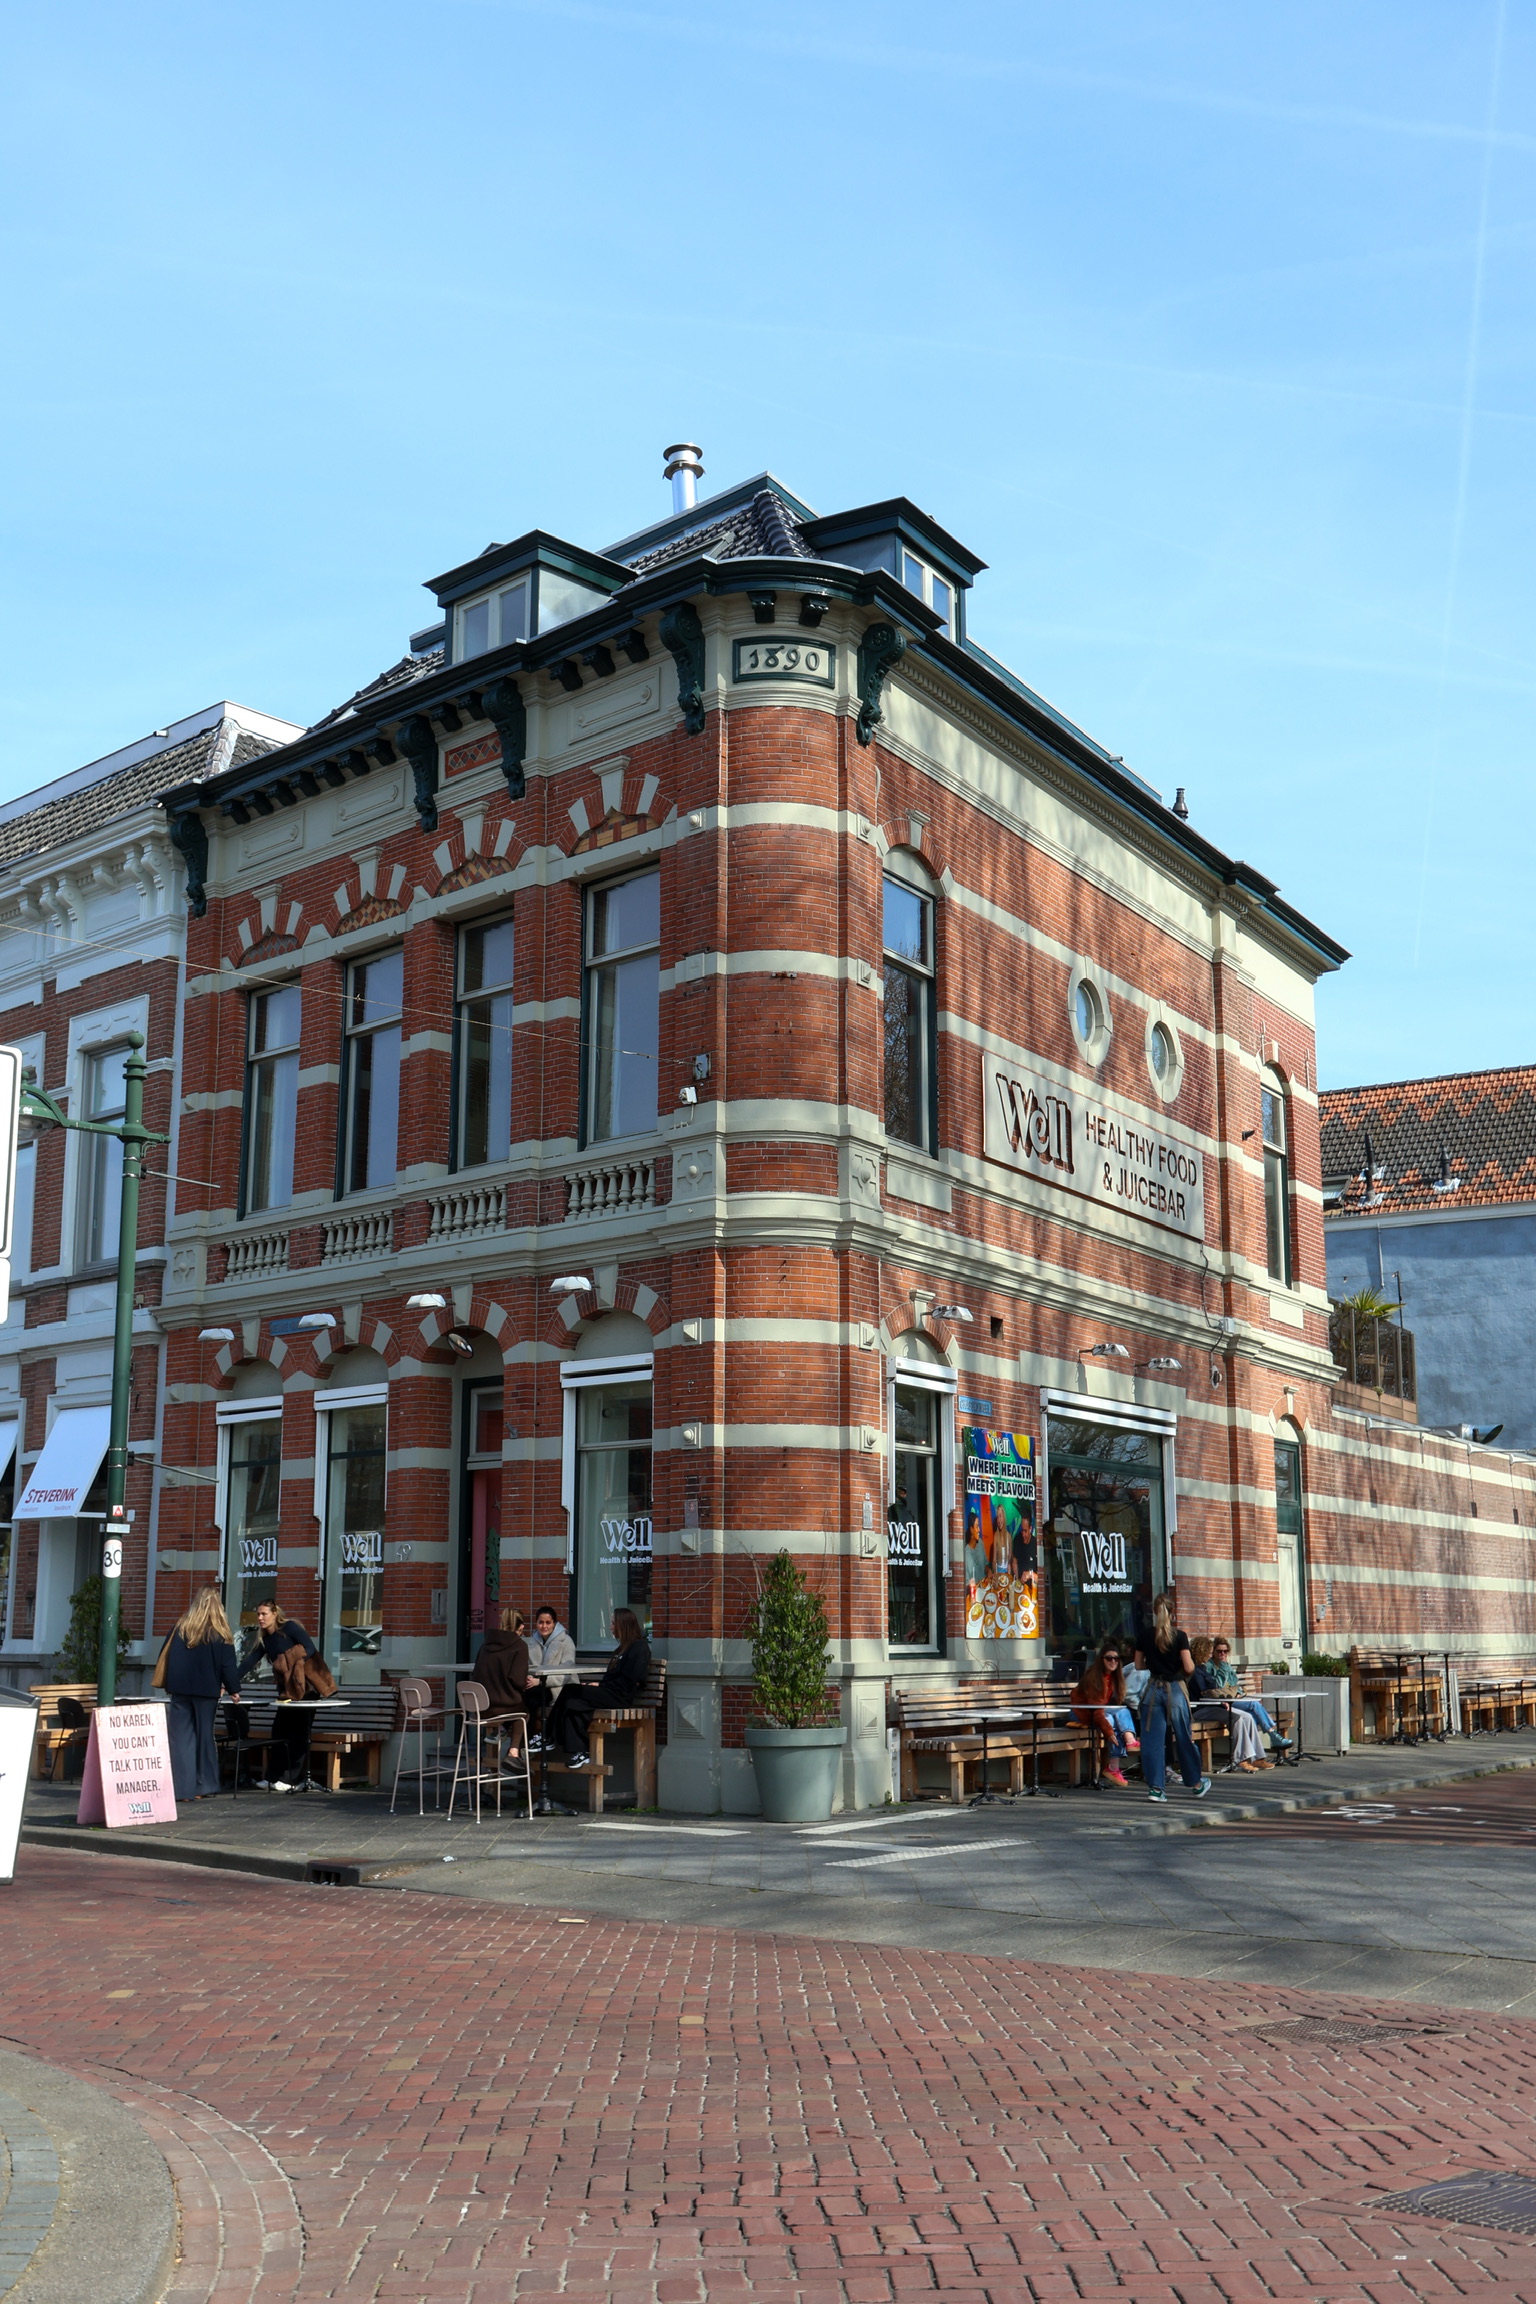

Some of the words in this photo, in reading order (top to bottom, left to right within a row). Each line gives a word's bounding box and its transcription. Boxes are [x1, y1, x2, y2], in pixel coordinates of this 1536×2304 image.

[749, 645, 820, 671] 1890
[995, 1072, 1074, 1175] Well
[1085, 1110, 1155, 1168] HEALTHY
[1158, 1144, 1198, 1187] FOOD
[1102, 1161, 1113, 1192] &
[1115, 1167, 1186, 1221] JUICEBAR
[992, 1437, 1010, 1457] Well
[968, 1457, 1000, 1475] WHERE
[1001, 1462, 1032, 1480] HEALTH
[25, 1488, 79, 1503] STEVERINK
[967, 1476, 996, 1494] MEETS
[997, 1481, 1035, 1498] FLAVOUR
[600, 1518, 653, 1552] Well
[887, 1521, 921, 1554] Well
[103, 1549, 122, 1567] 30
[239, 1537, 277, 1567] Well
[339, 1532, 382, 1563] Well
[1081, 1531, 1127, 1579] Well
[600, 1556, 620, 1564] Health
[621, 1556, 628, 1564] &
[1082, 1583, 1102, 1593] Health
[1102, 1583, 1108, 1593] &
[1108, 1583, 1133, 1593] JuiceBar
[109, 1716, 121, 1728] NO
[112, 1737, 130, 1750] YOU
[131, 1735, 155, 1748] CAN'T
[109, 1760, 132, 1773] TALK
[133, 1758, 144, 1771] TO
[145, 1756, 162, 1770] THE
[116, 1780, 161, 1795] MANAGER.
[128, 1801, 152, 1814] Well
